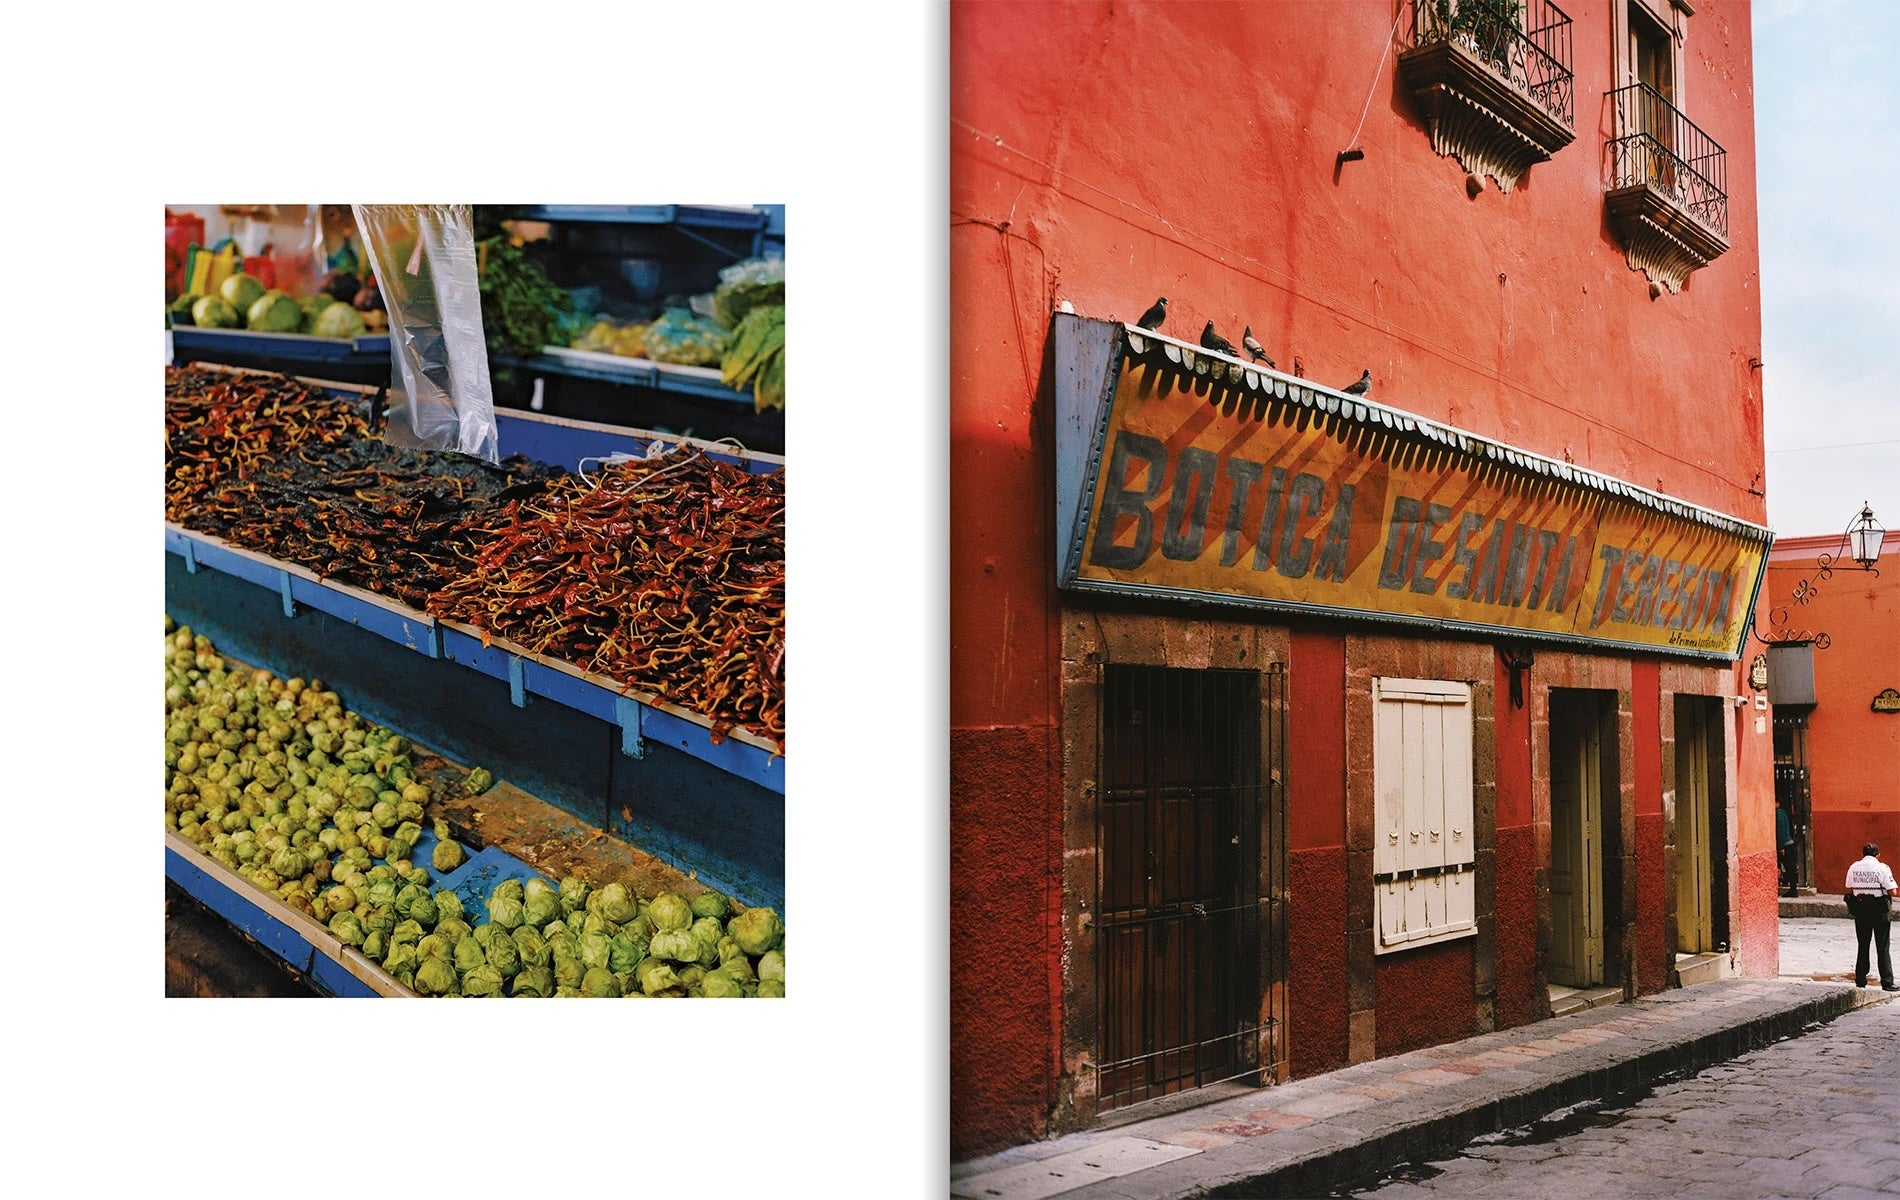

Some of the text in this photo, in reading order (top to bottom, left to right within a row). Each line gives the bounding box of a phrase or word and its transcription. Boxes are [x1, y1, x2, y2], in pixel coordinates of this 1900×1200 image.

[1091, 430, 1734, 635] BOTICA DE SANTA TERESITA
